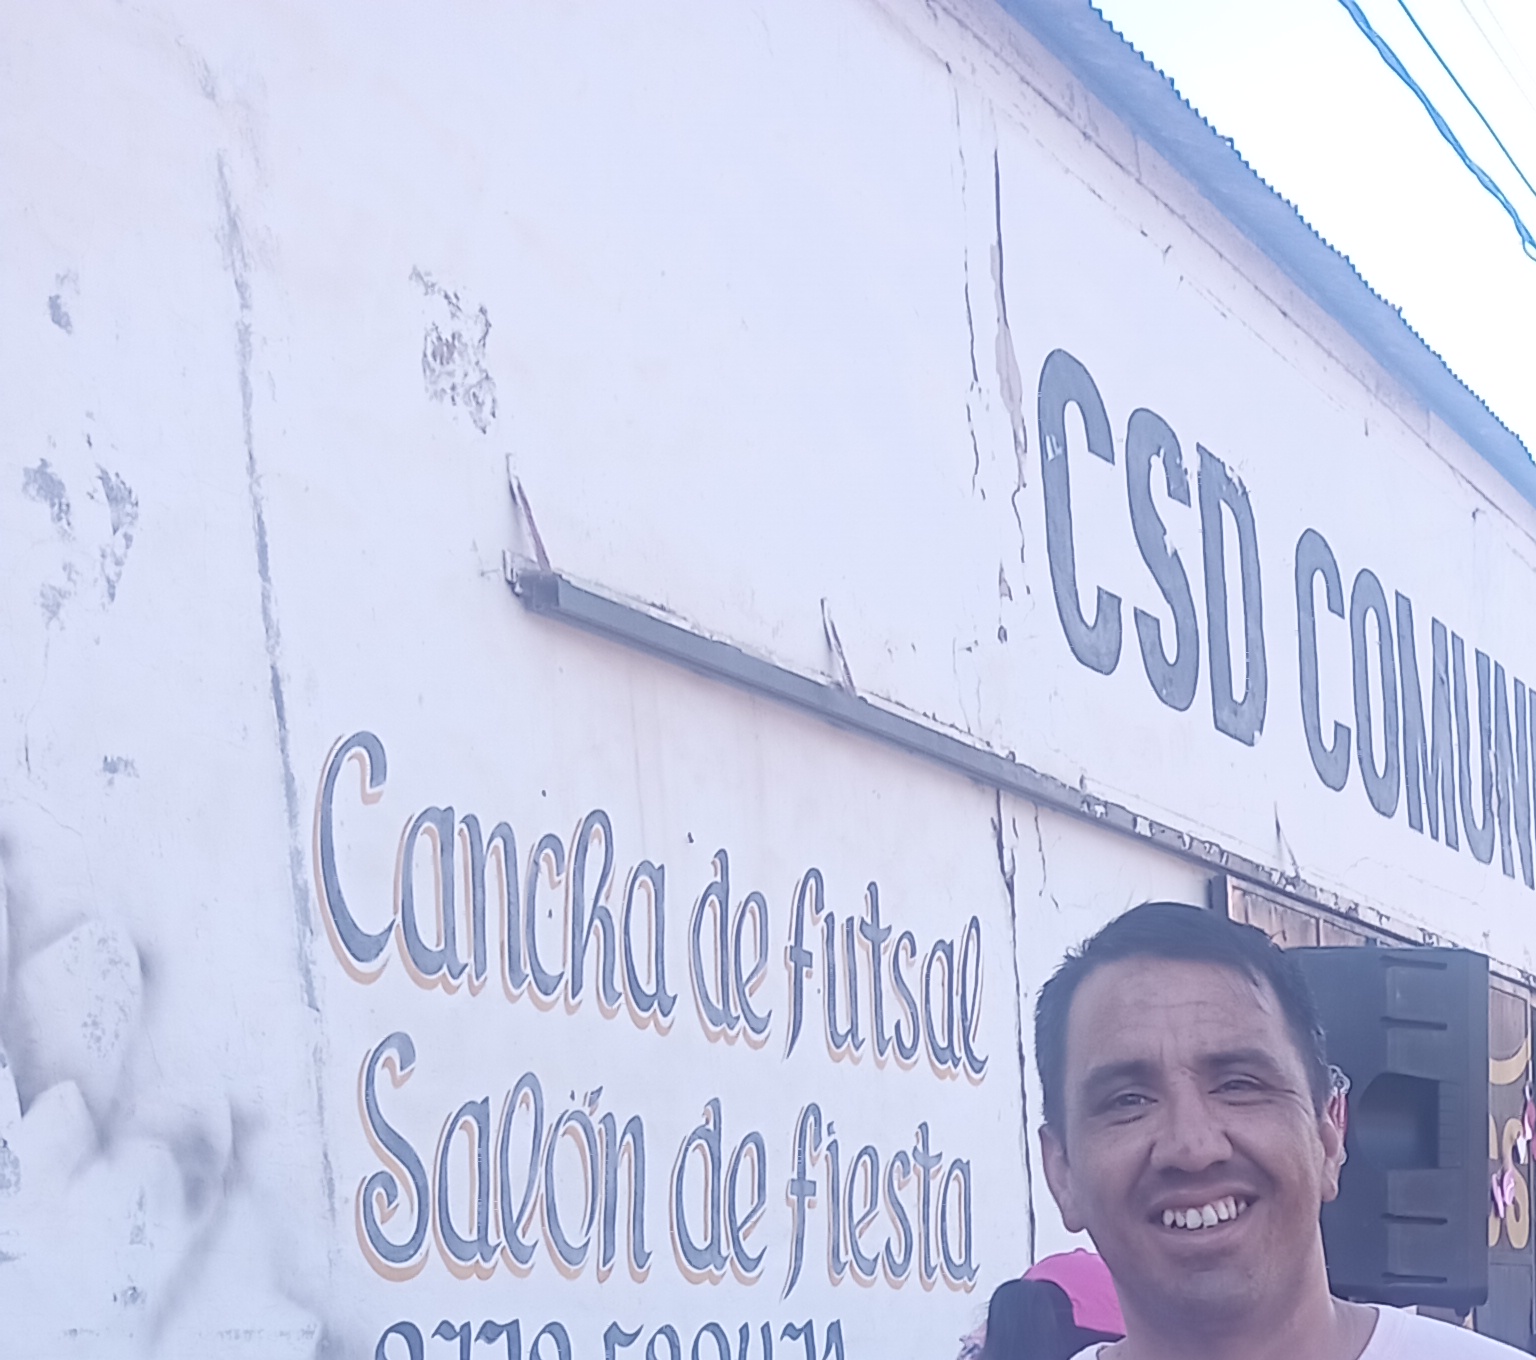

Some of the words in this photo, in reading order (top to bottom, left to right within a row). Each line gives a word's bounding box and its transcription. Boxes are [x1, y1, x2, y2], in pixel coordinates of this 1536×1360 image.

[1037, 348, 1268, 747] CSD
[314, 730, 680, 1034] Cancha
[690, 847, 773, 1040] de
[783, 866, 990, 1080] futsal
[671, 1097, 769, 1277] de
[782, 1102, 982, 1300] fiesta
